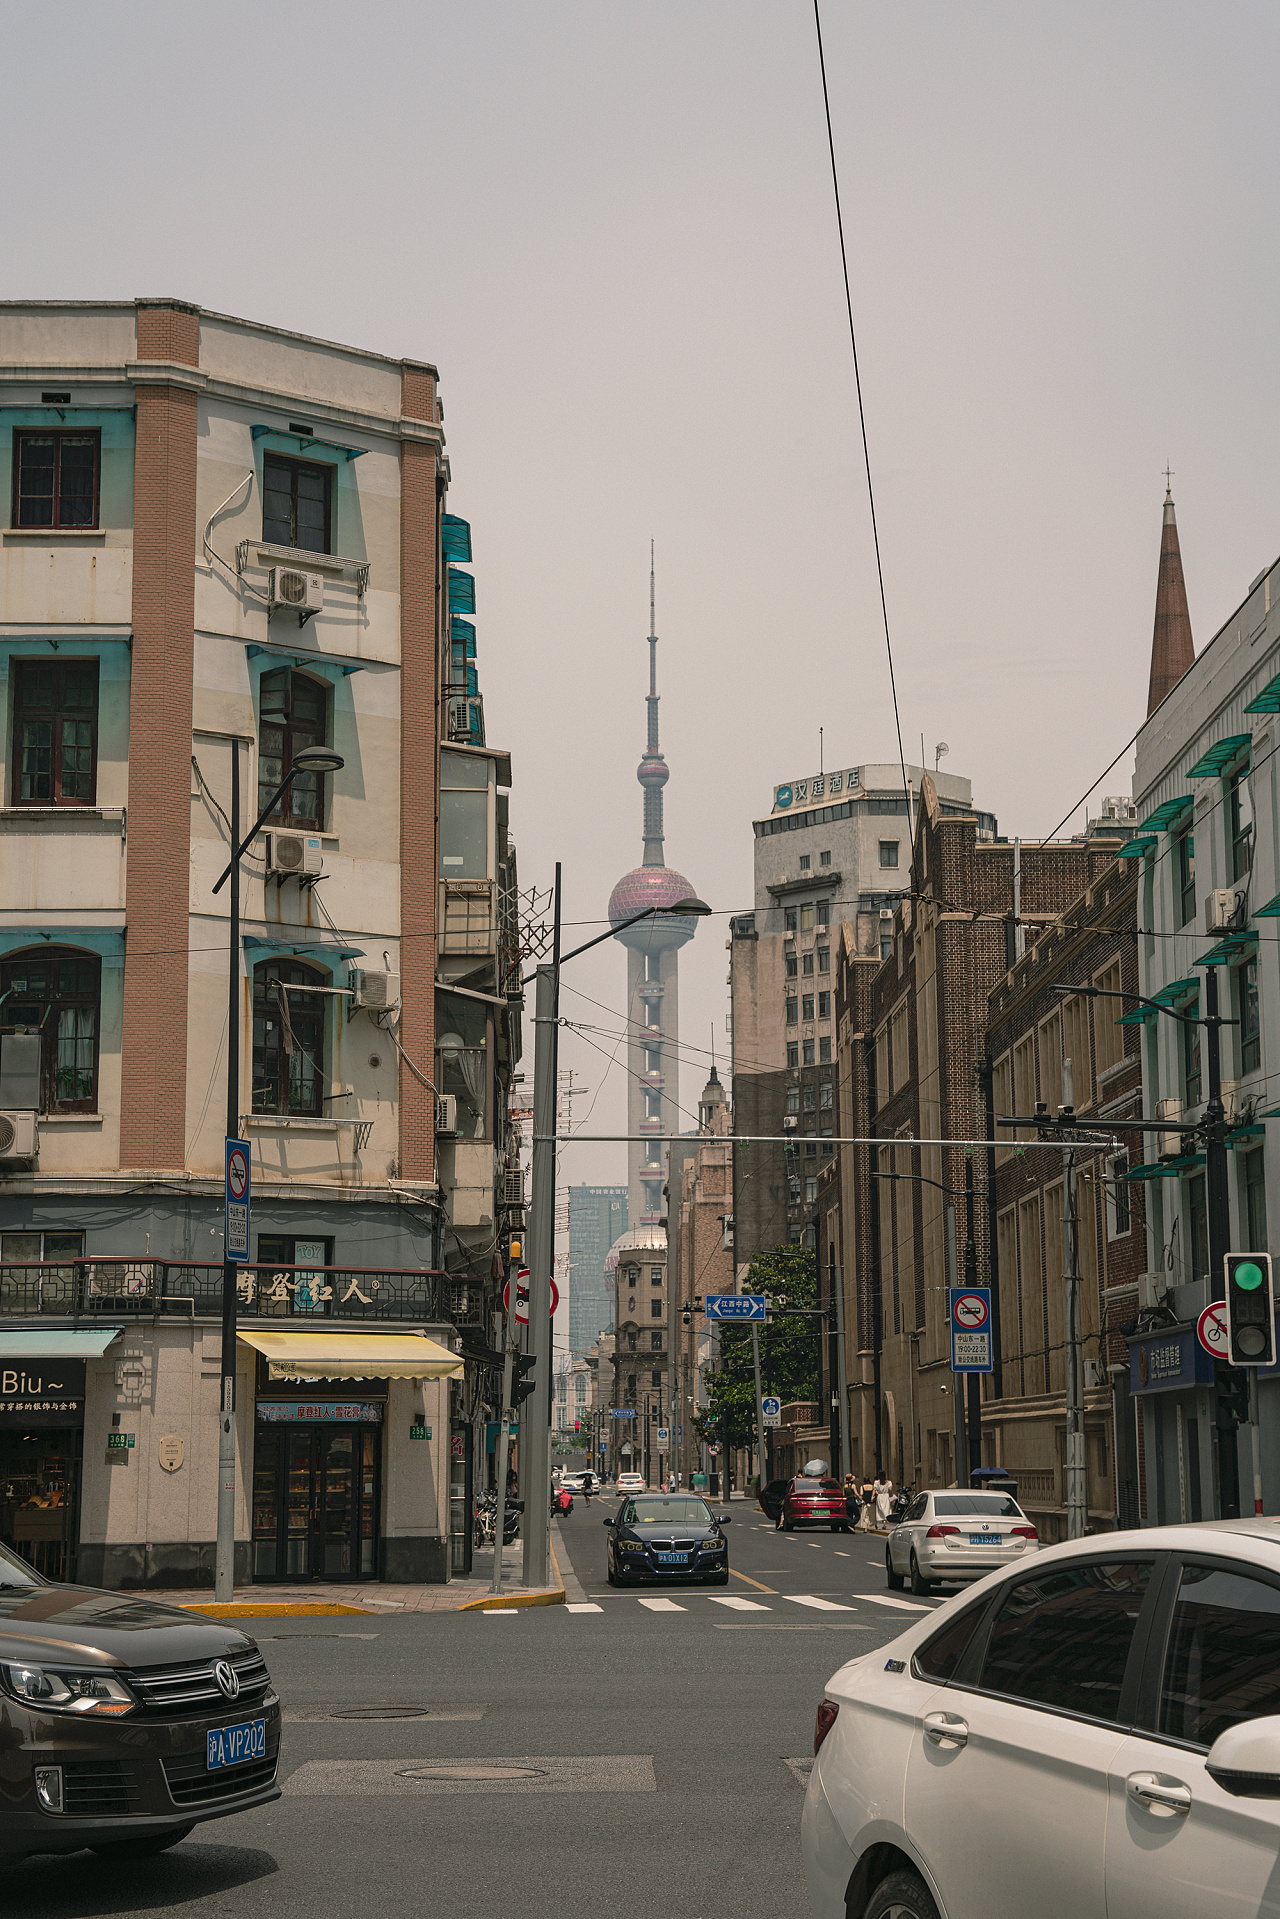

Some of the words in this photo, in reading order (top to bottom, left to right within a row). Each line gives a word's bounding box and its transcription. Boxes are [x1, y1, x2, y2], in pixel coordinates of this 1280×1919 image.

[795, 768, 859, 800] 汉庭酒店
[297, 1245, 321, 1259] TOY
[957, 1335, 986, 1343] 中山东一路
[2, 1370, 42, 1393] Biu
[110, 1435, 125, 1443] 368
